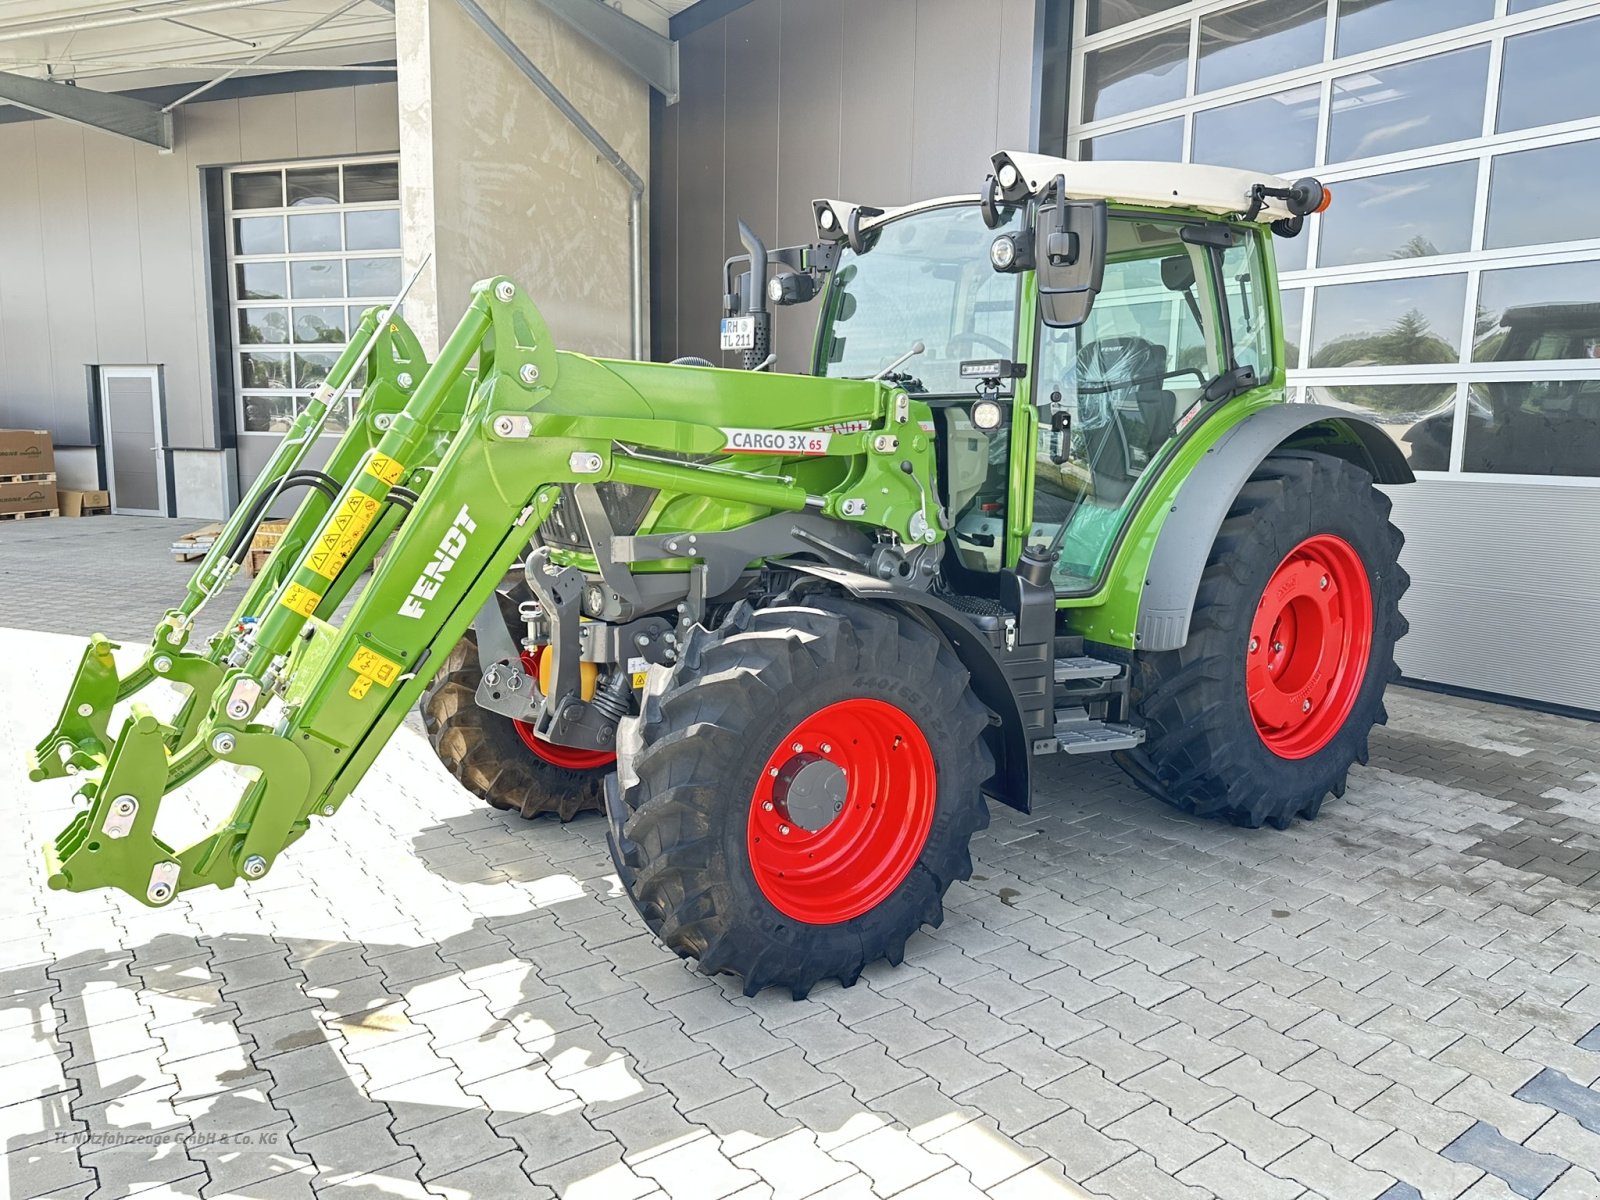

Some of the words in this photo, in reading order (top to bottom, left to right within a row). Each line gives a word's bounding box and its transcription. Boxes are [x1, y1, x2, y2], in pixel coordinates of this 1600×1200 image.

[727, 320, 738, 333] RH
[723, 335, 733, 347] TL
[735, 334, 751, 347] 211
[732, 432, 785, 449] CARGO
[788, 435, 807, 450] 3X
[809, 439, 822, 450] 65
[397, 503, 477, 620] FENDT
